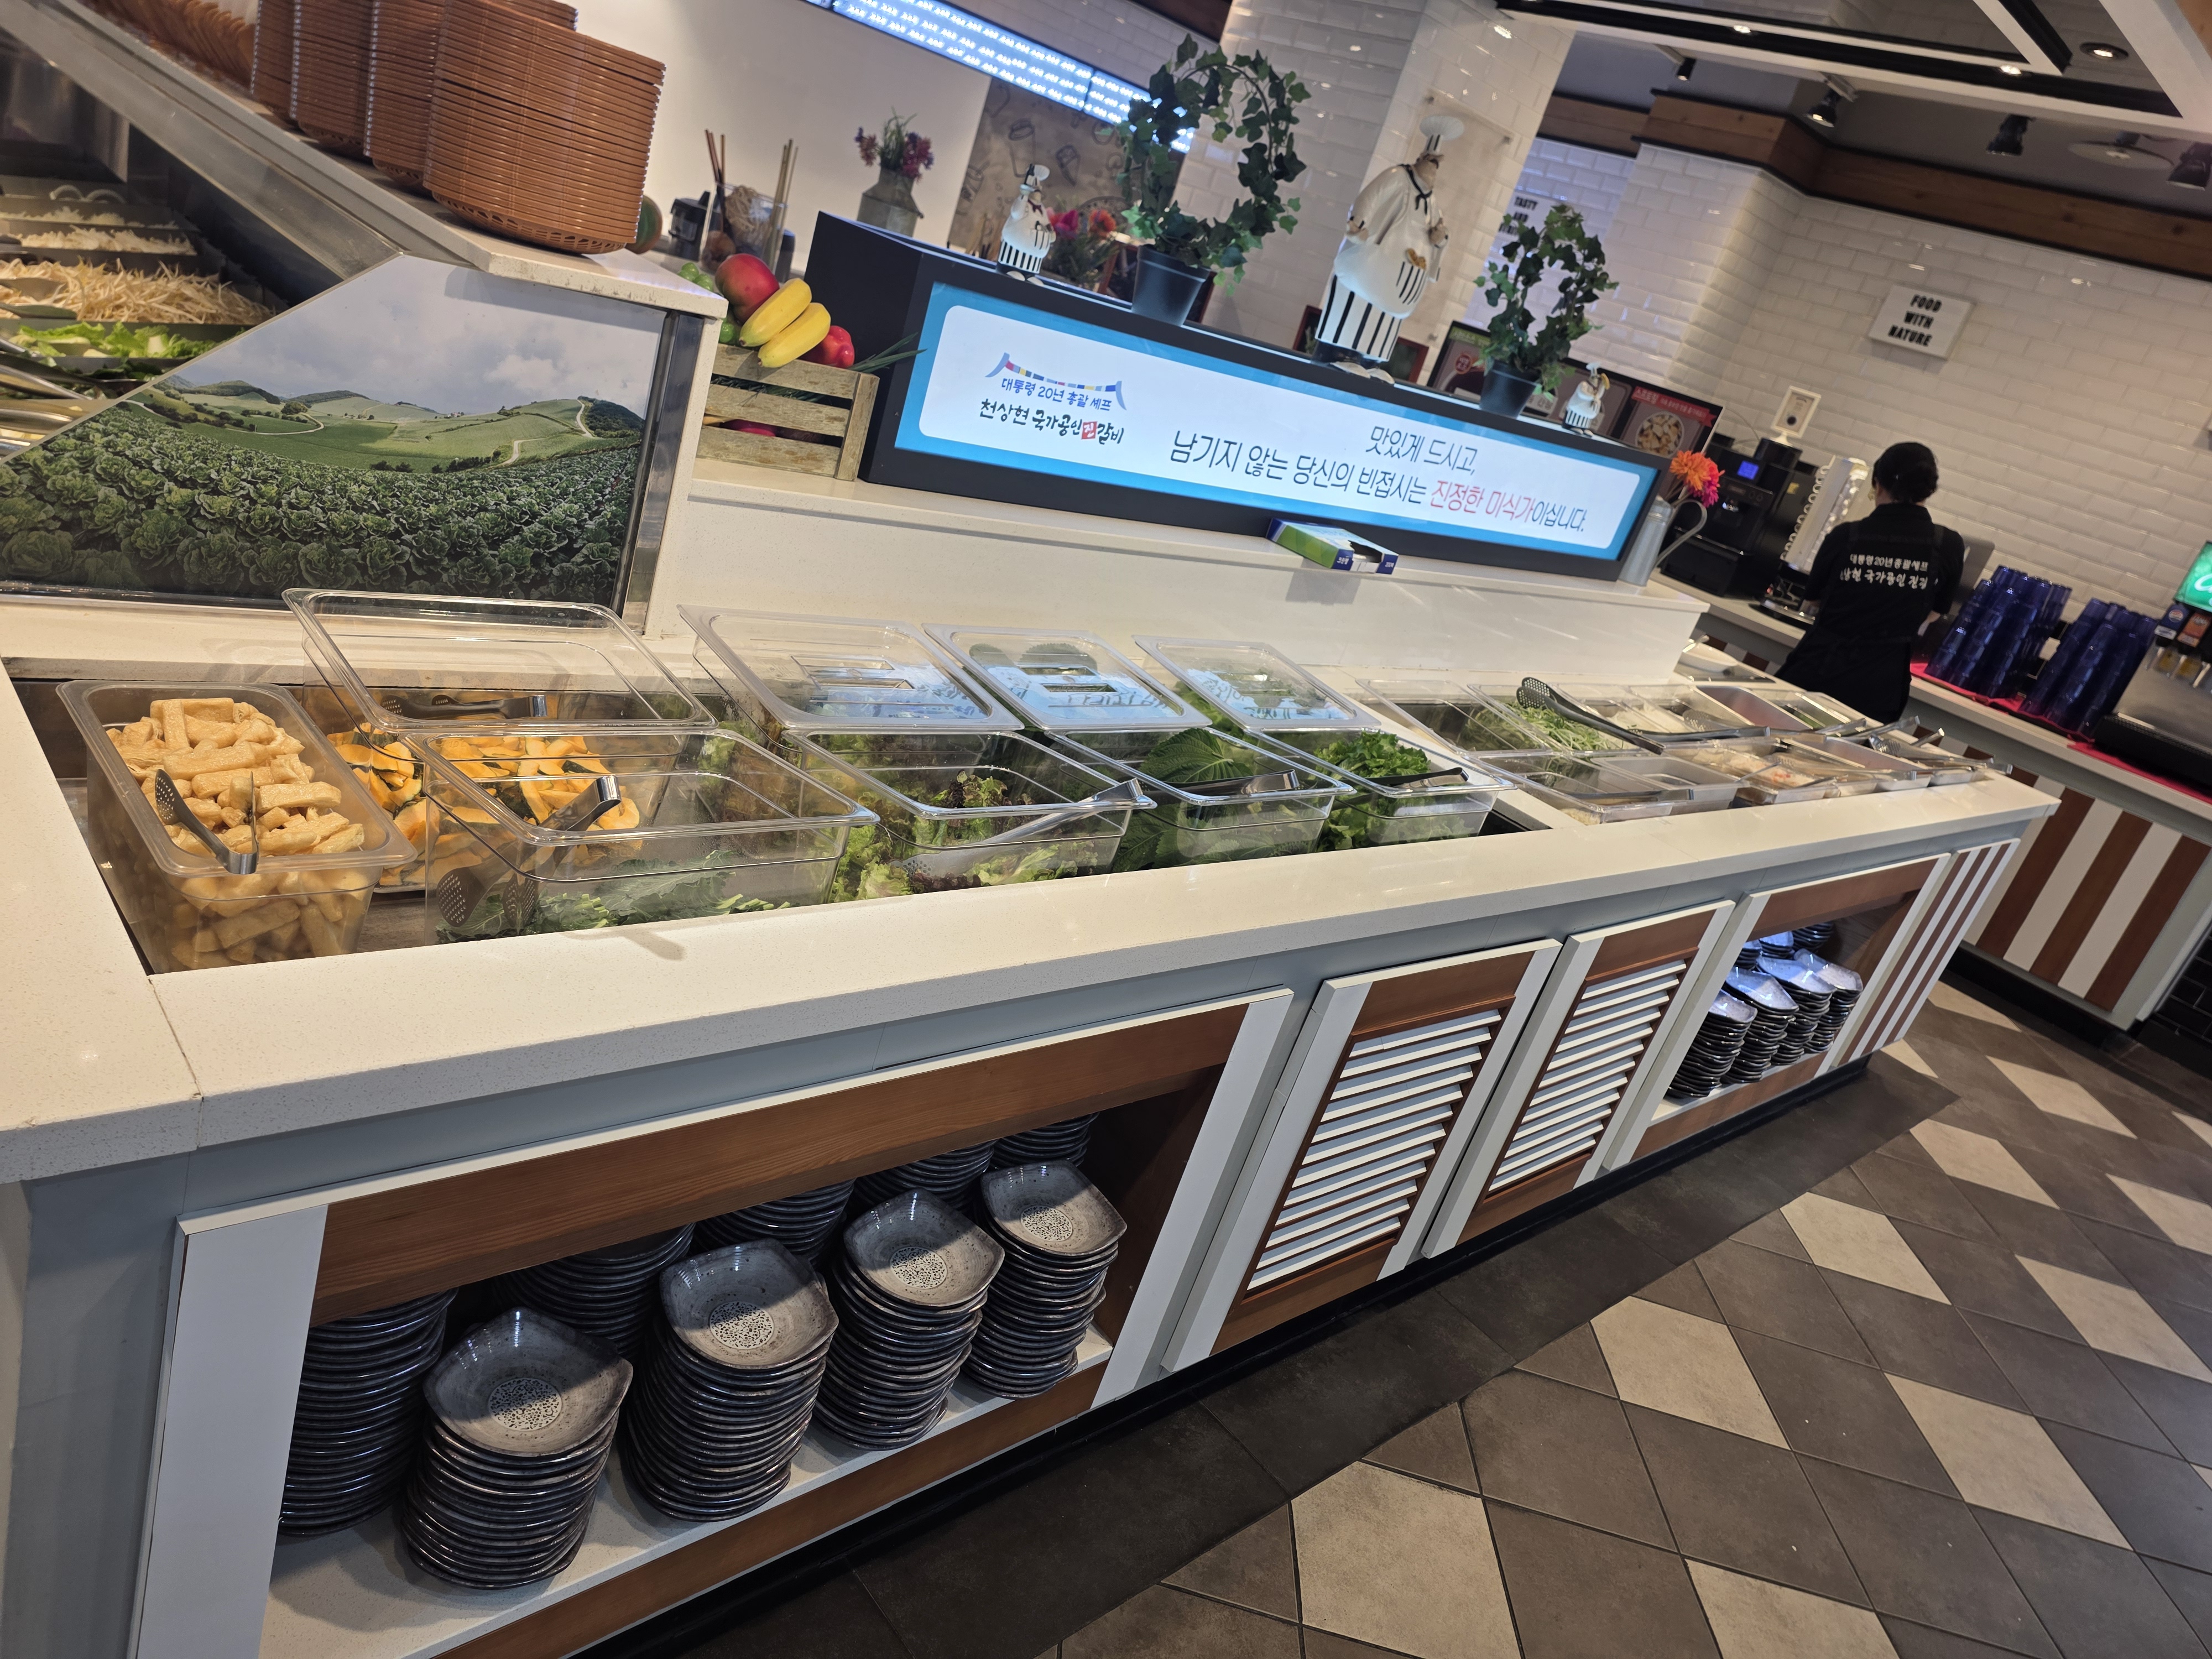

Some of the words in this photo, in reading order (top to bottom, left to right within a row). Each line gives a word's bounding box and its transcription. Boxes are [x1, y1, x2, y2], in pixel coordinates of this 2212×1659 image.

[1911, 295, 1942, 312] FOOD
[1904, 311, 1934, 329] WITH
[1888, 325, 1932, 346] NATURE
[1001, 378, 1036, 397] 대통령
[1037, 386, 1065, 403] 20년
[1066, 391, 1089, 408] 총괄
[1089, 397, 1112, 411] 셰프
[979, 398, 1030, 426] 천상현
[1365, 426, 1426, 463] 맛있게
[1423, 439, 1478, 476] 드시고,
[1170, 430, 1243, 472] 남기지
[1245, 446, 1288, 480] 않는
[1293, 455, 1355, 492] 당신의
[1357, 467, 1427, 504] 빈접시는
[1431, 479, 1485, 514] 진정한
[1485, 491, 1588, 533] 미식가이십니다.
